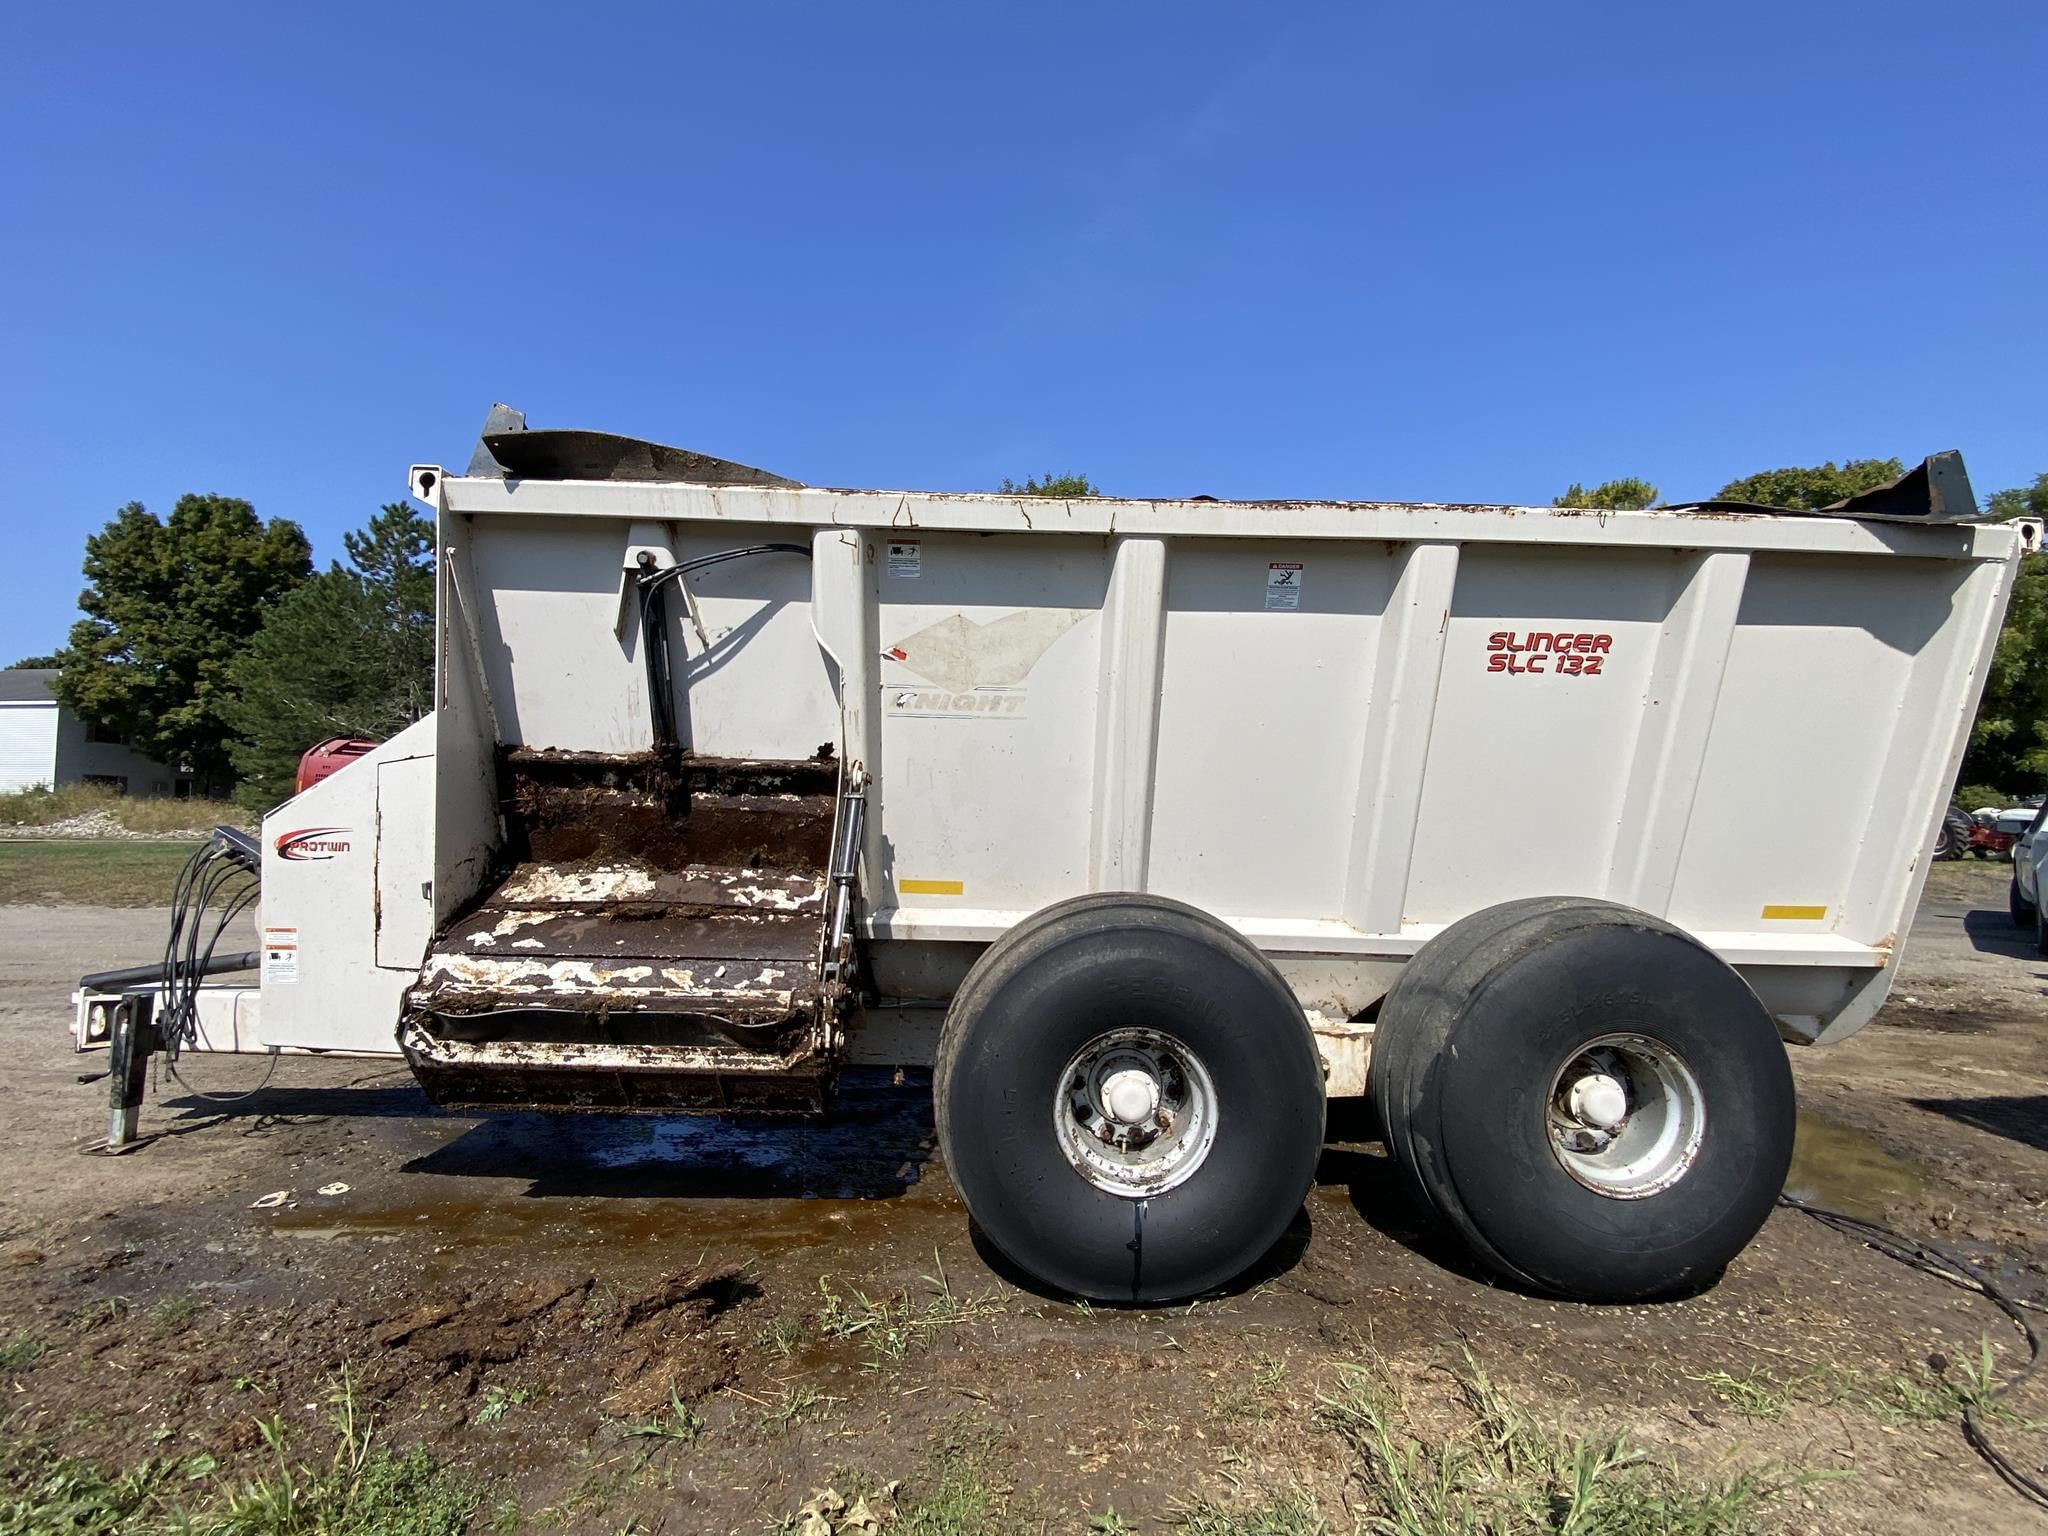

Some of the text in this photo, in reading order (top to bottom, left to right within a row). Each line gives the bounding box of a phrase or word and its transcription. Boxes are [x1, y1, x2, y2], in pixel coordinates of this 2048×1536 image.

[1487, 631, 1613, 653] SLINGER
[1487, 654, 1605, 675] SLC 132
[289, 841, 350, 852] PROTWIN
